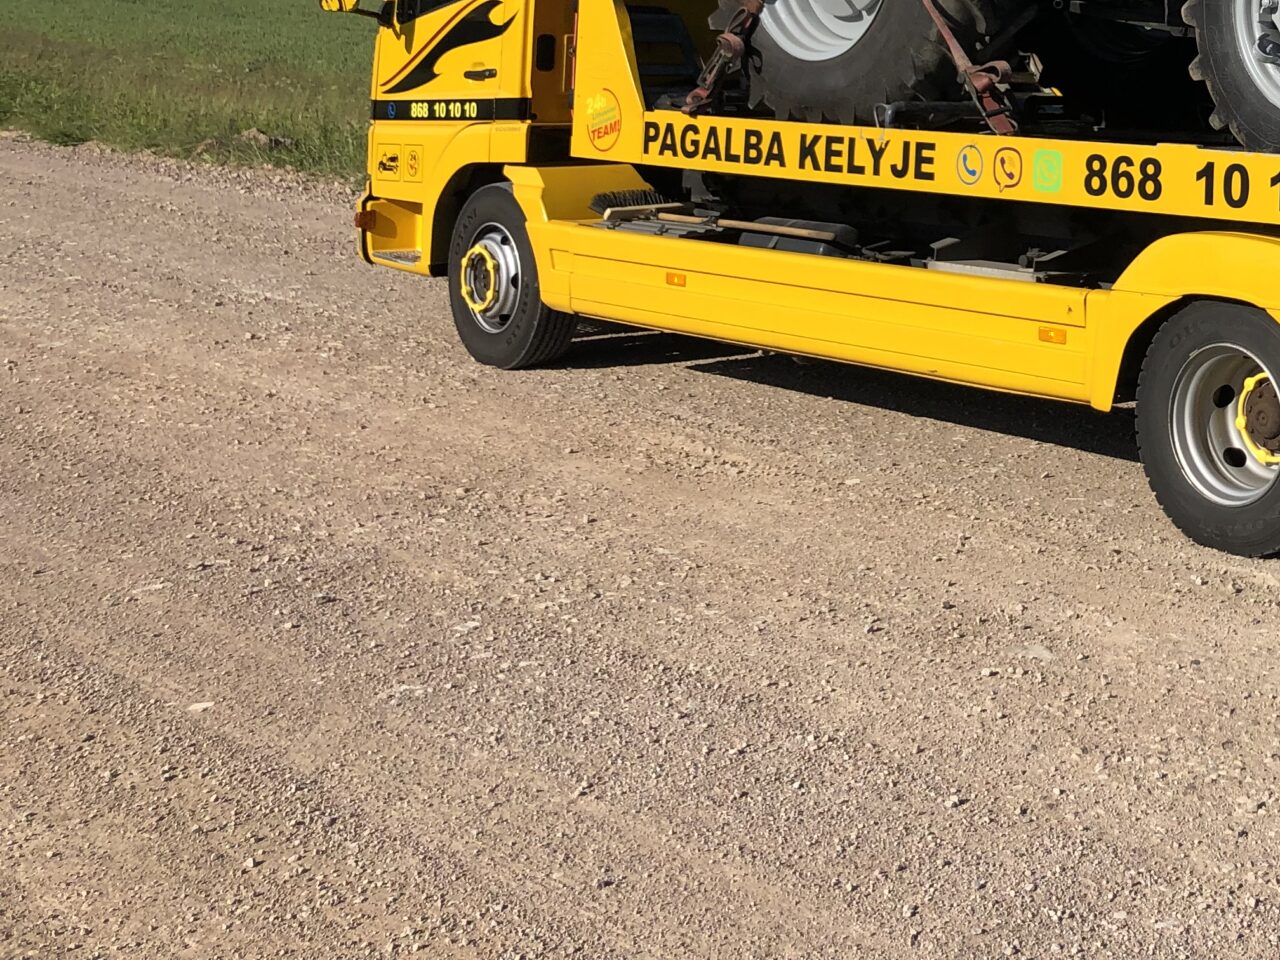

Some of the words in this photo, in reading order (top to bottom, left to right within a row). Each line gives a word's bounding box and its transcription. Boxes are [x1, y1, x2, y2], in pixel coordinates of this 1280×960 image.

[410, 102, 429, 118] 868
[433, 102, 446, 118] 10
[449, 102, 462, 118] 10
[464, 102, 477, 118] 10
[643, 121, 786, 168] PAGALBA
[799, 133, 936, 181] KELYJE
[1084, 153, 1163, 201] 868
[1195, 161, 1250, 209] 10
